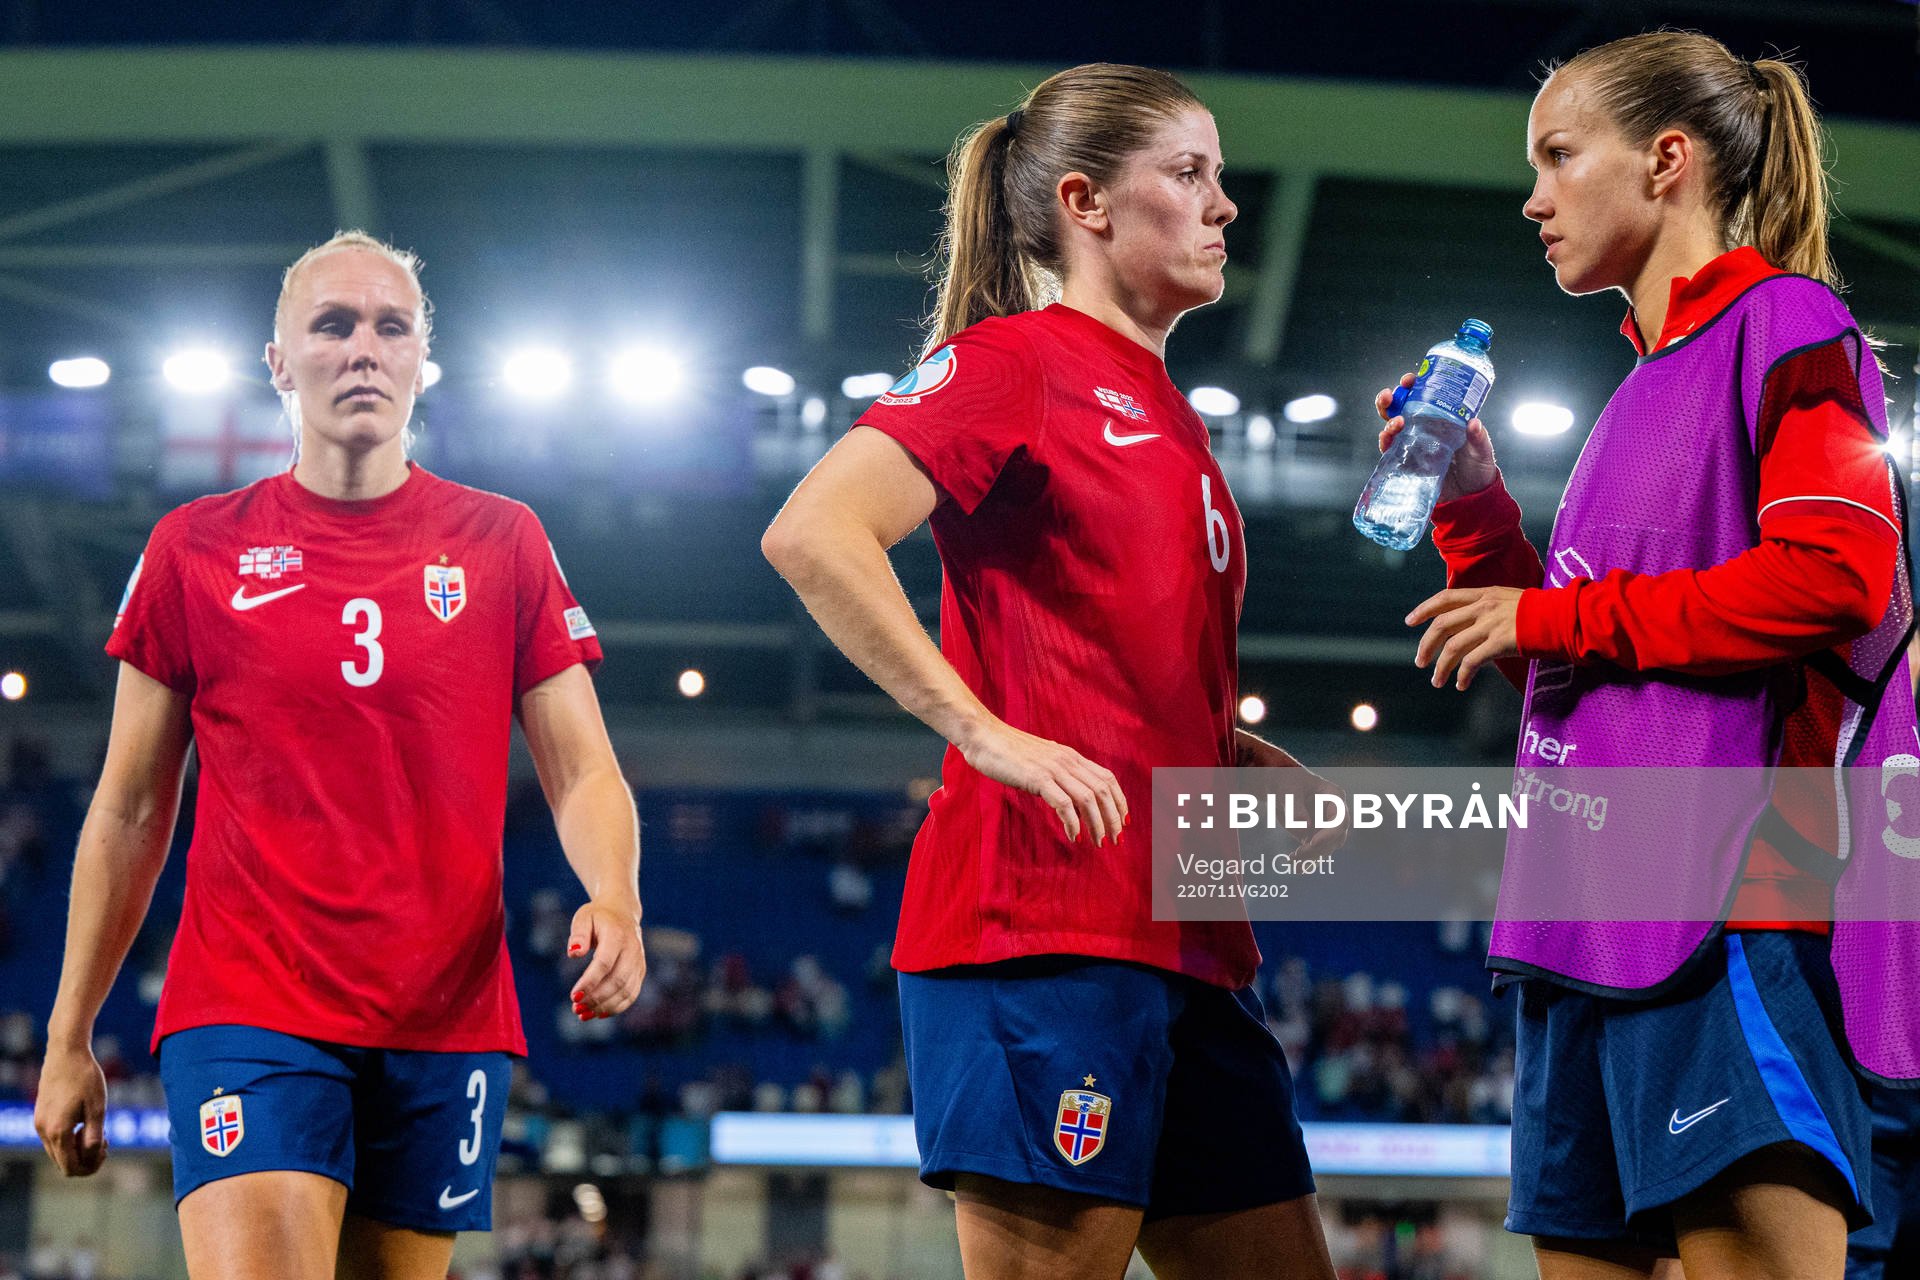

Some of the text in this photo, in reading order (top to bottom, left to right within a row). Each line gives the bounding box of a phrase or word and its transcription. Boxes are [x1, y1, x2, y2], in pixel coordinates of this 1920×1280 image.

[1201, 473, 1231, 573] 6
[340, 598, 384, 687] 3
[459, 1069, 487, 1165] 3
